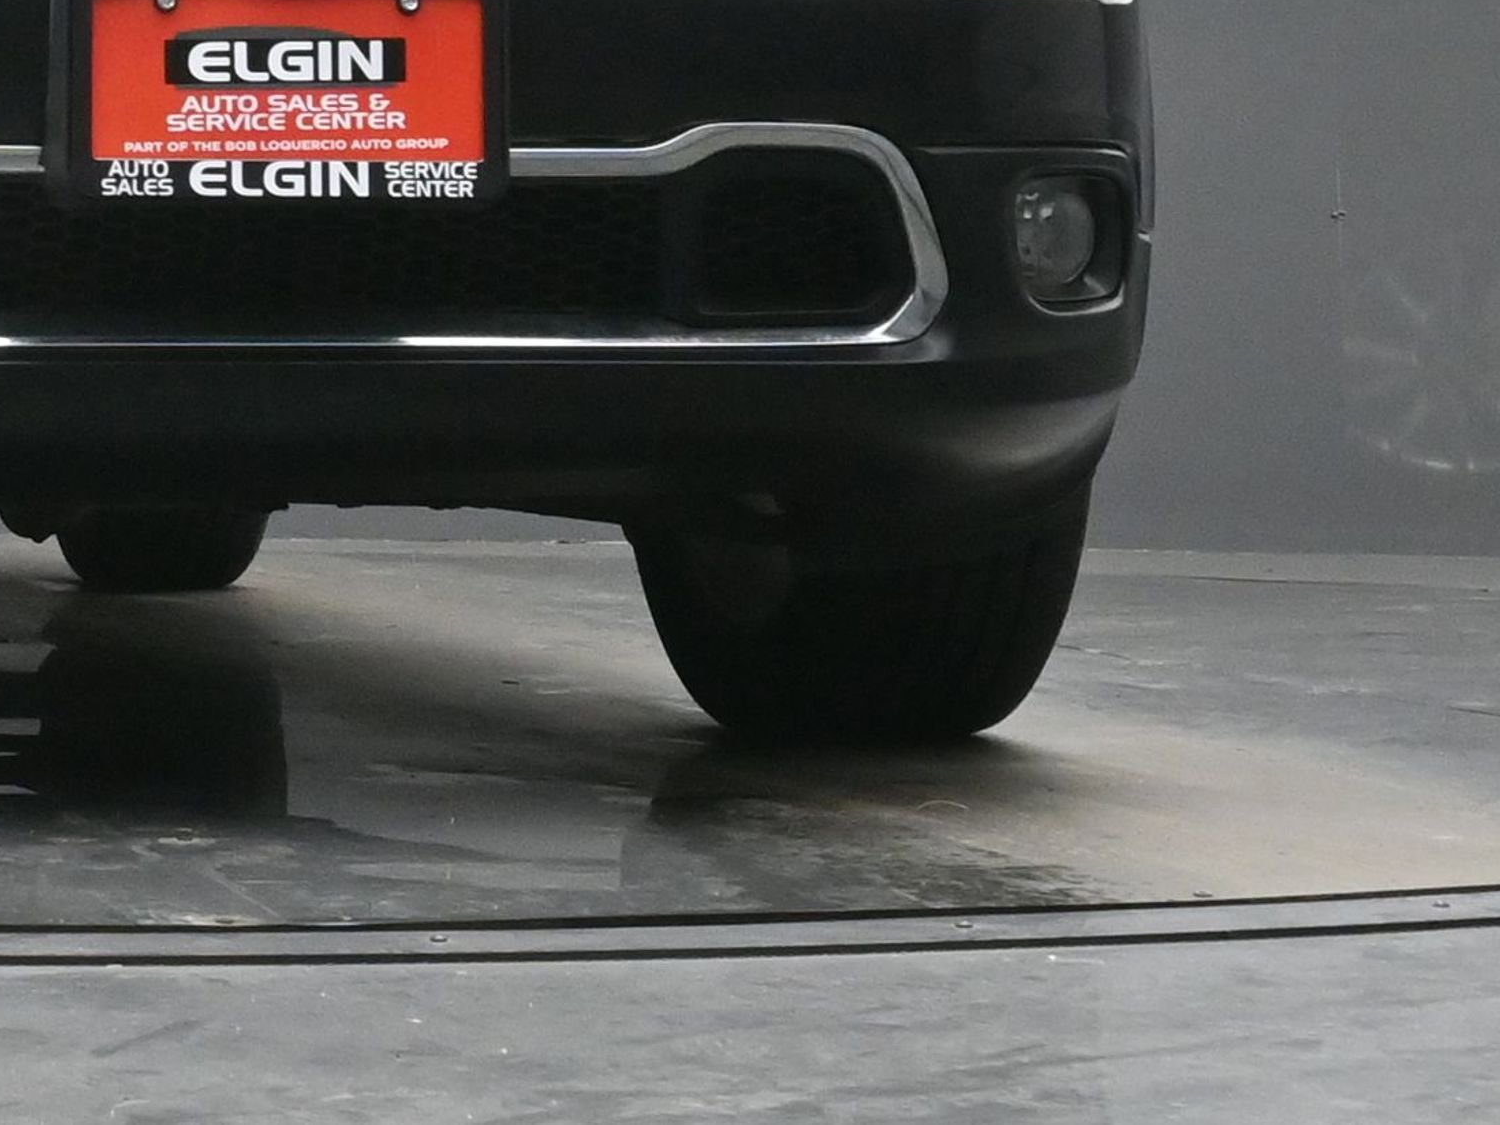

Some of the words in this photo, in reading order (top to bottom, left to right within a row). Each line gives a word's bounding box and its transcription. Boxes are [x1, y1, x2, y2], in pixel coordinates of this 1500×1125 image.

[188, 41, 383, 82] ELGIN
[181, 95, 258, 112] AUTO
[268, 94, 358, 112] SALES
[368, 94, 390, 110] &
[166, 113, 286, 131] SERVICE
[296, 112, 406, 130] CENTER
[124, 142, 163, 153] PART
[167, 142, 188, 152] OF
[191, 141, 221, 152] THE
[225, 140, 257, 151] BOB
[260, 139, 347, 151] LOQUERCIO
[351, 139, 392, 150] AUTO
[395, 138, 448, 150] GROUP
[108, 160, 169, 178] AUTO
[384, 161, 478, 180] SERVICE
[101, 179, 173, 196] SALES
[188, 160, 370, 197] ELGIN
[388, 180, 474, 198] CENTER
